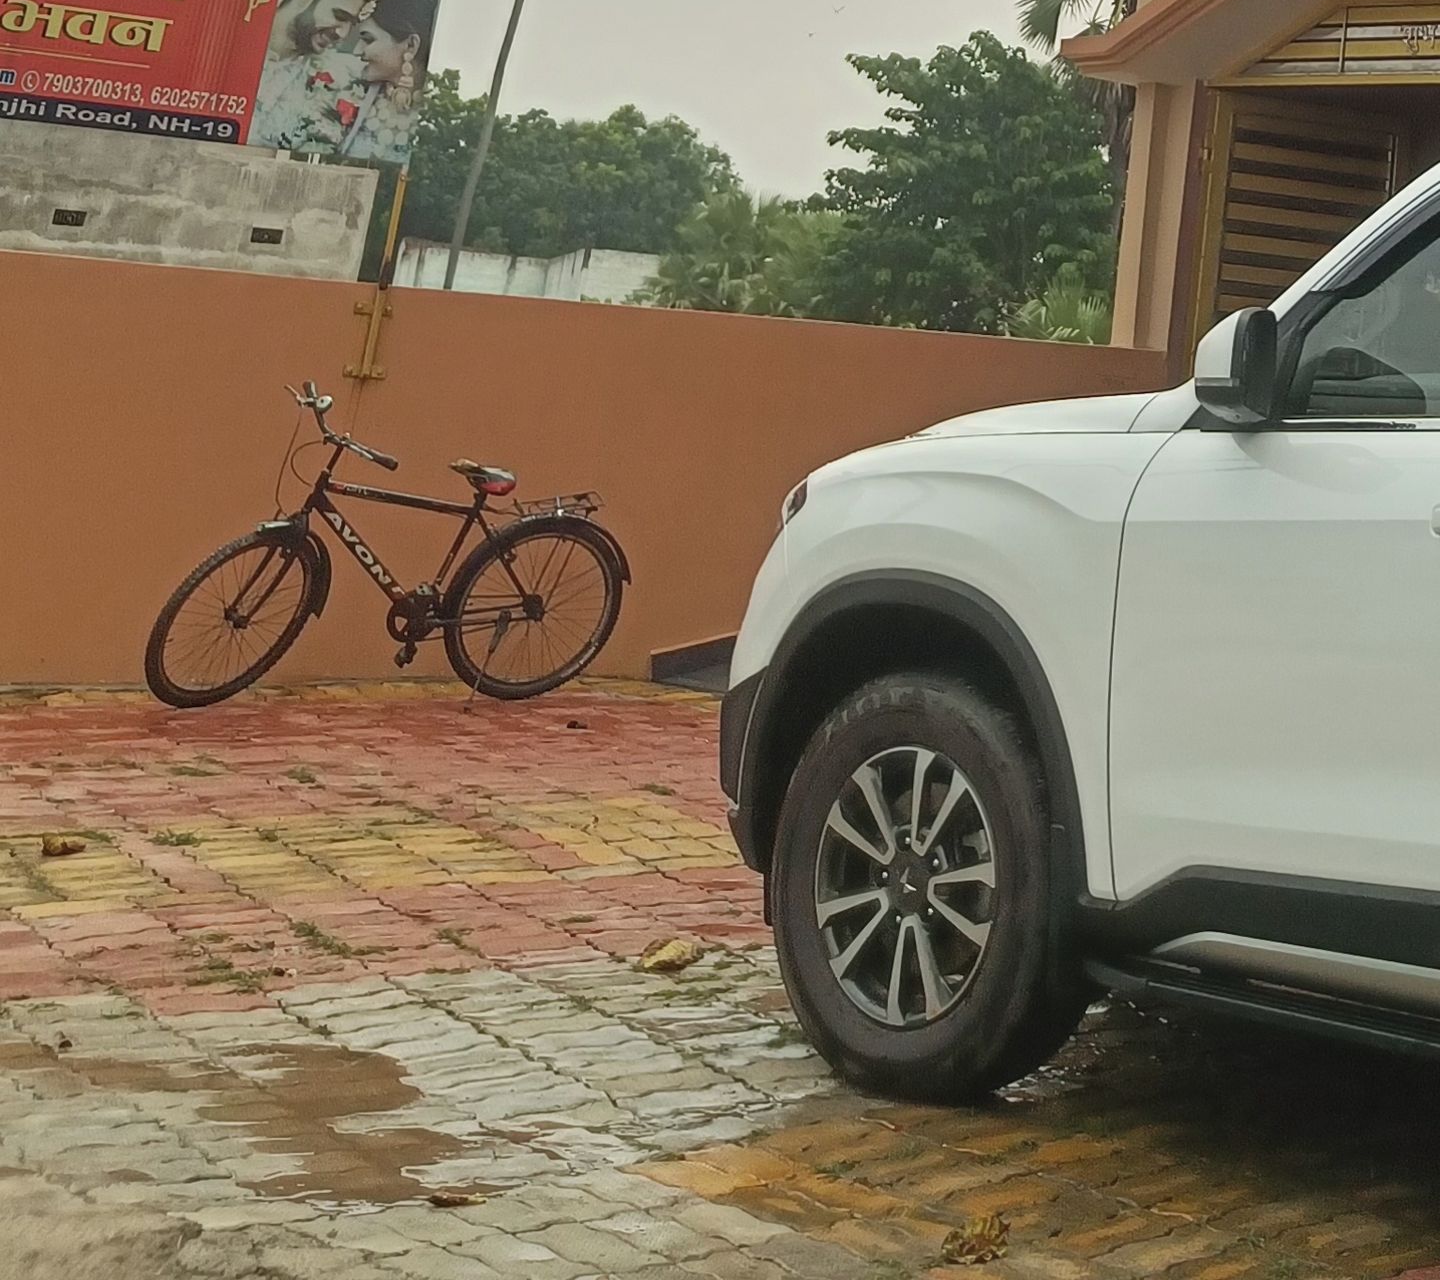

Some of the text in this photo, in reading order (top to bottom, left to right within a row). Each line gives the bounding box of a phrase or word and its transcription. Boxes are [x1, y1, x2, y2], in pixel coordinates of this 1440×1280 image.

[44, 73, 145, 106] 7903700313,
[150, 87, 247, 115] 6202571752
[55, 103, 137, 129] Road,
[149, 114, 233, 137] NH-19
[324, 511, 392, 585] AVON
